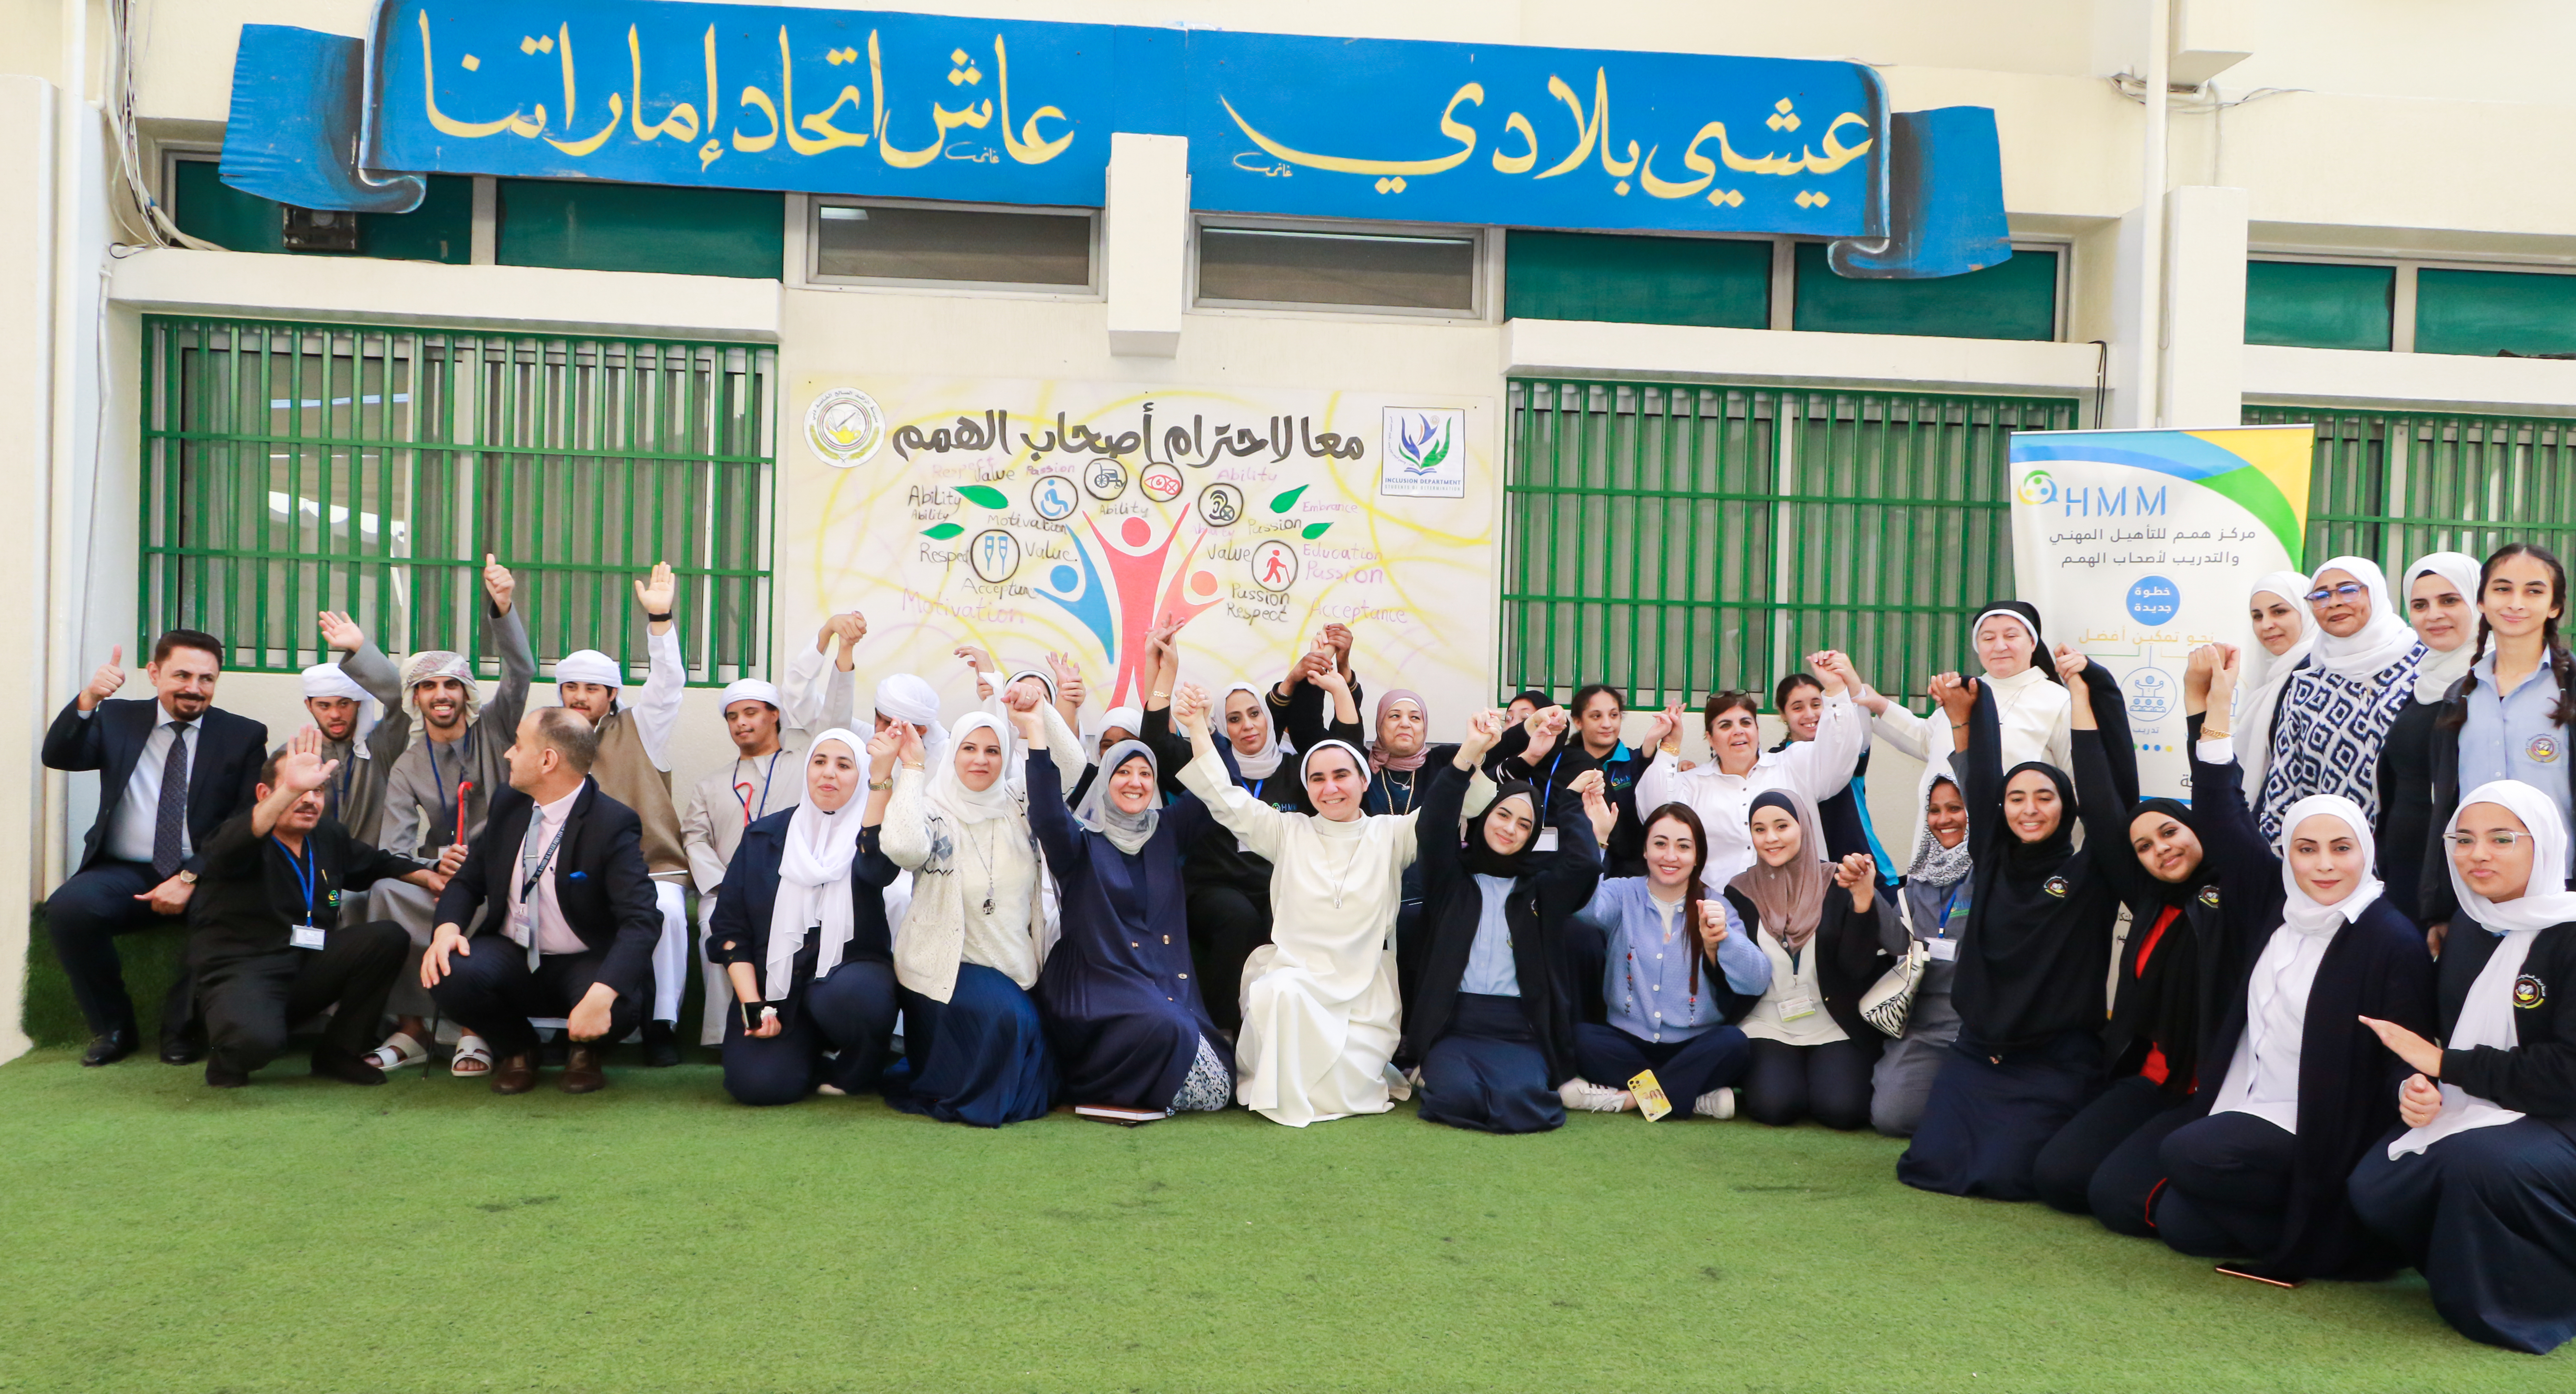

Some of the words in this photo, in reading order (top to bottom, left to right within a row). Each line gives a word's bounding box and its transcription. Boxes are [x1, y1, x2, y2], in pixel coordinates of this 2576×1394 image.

[418, 10, 723, 170] إماراتنا
[733, 25, 884, 155] اتحاد
[880, 34, 1074, 168] عاش
[1222, 67, 1640, 195] بلادي
[1641, 98, 1874, 208] عيشي
[892, 409, 1011, 462] الهمم
[1020, 402, 1155, 463] أصحاب
[1164, 414, 1293, 469] لاحترام
[1301, 416, 1365, 460] معا
[1026, 463, 1075, 476] Passion
[1217, 467, 1277, 483] Ability
[908, 485, 961, 516] Ability
[1100, 501, 1148, 518] Ability
[2066, 485, 2166, 517] HMM
[911, 509, 949, 522] Ability
[1248, 518, 1302, 535] Passion
[2110, 524, 2166, 543] للتأهيل
[2217, 527, 2256, 542] مركز
[2049, 529, 2103, 545] المهني
[2173, 530, 2211, 543] همم
[1207, 539, 1251, 562] Value
[1303, 542, 1383, 561] Education
[2061, 552, 2106, 567] الهمم
[2113, 551, 2165, 566] لأصحاب
[2172, 552, 2240, 566] والتدريب
[1306, 560, 1383, 584] Passion
[1232, 583, 1290, 606] Passion
[2134, 586, 2171, 598] خطوة
[903, 588, 1024, 624] Motivation
[1226, 602, 1288, 626] Respect
[1309, 597, 1407, 624] Acceptance
[2134, 603, 2172, 613] جديدة
[2078, 626, 2126, 644] أفضل
[2132, 630, 2179, 645] تمكين
[2187, 632, 2214, 646] نحو
[2132, 727, 2160, 735] تدريب
